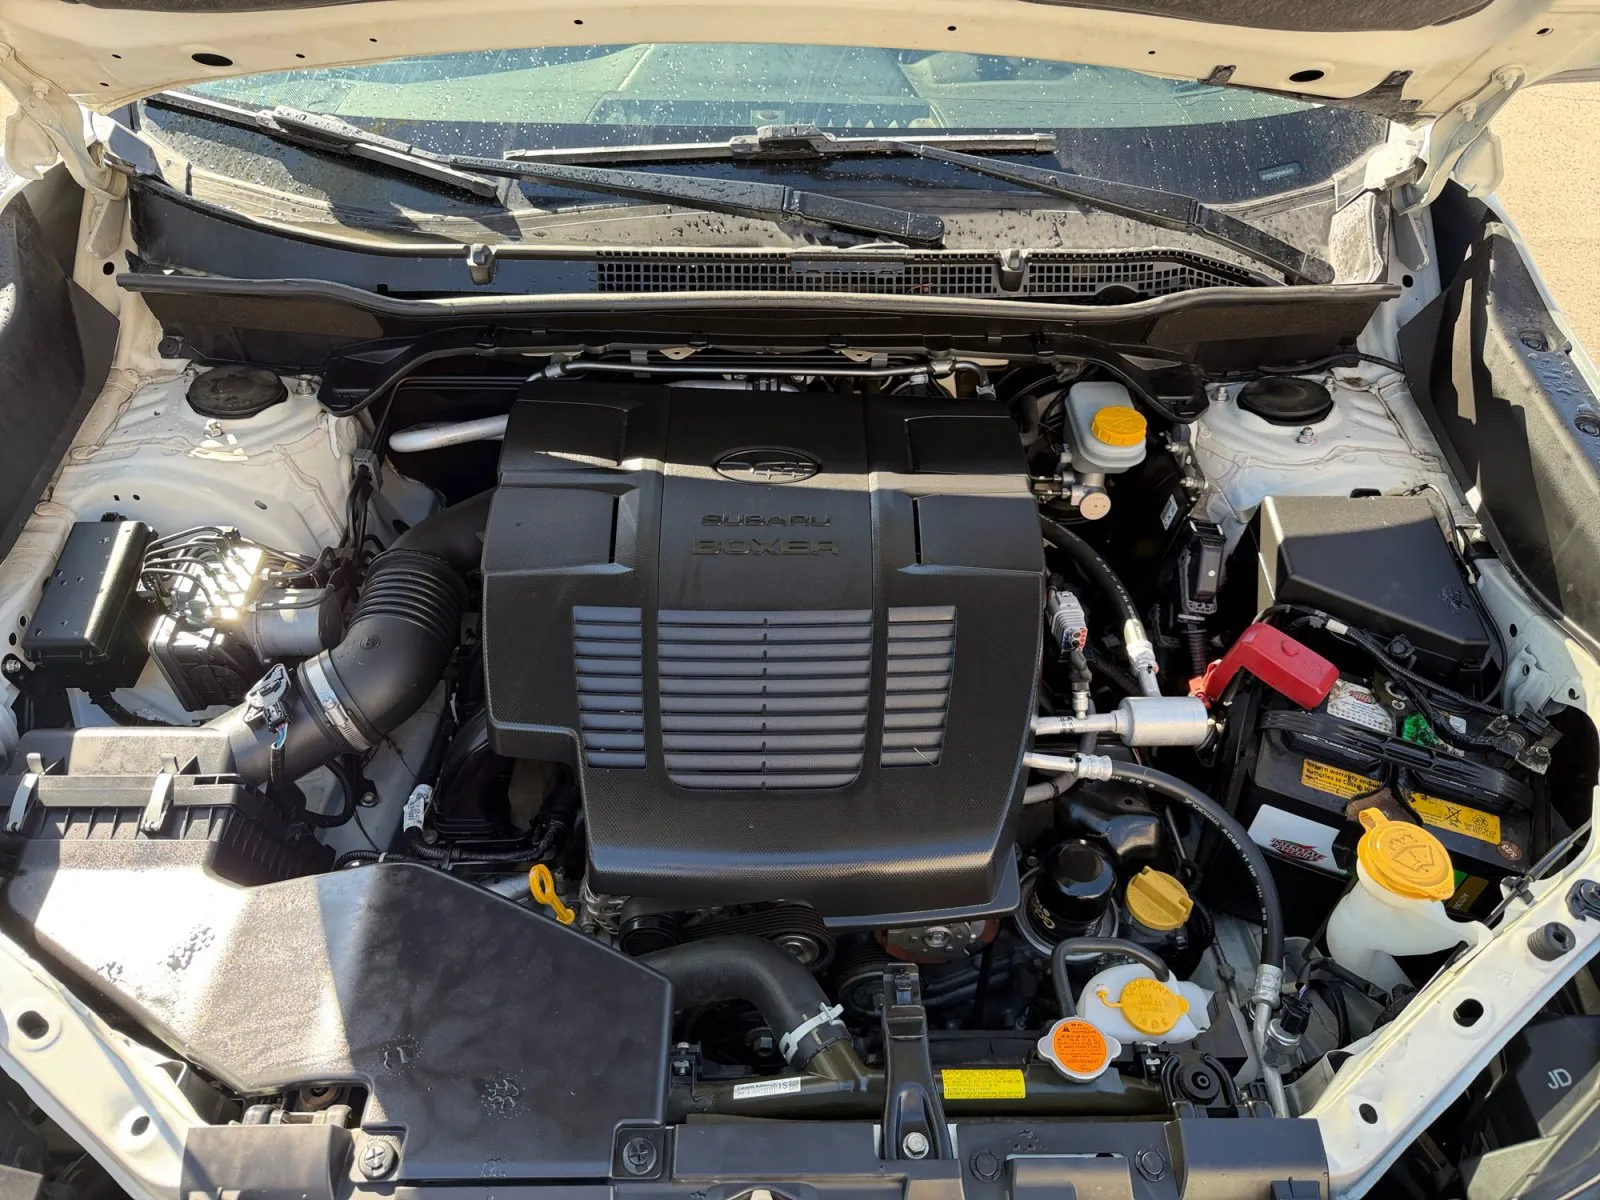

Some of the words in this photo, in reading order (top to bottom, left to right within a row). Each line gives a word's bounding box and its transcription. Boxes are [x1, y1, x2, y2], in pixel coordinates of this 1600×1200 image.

[701, 513, 831, 527] SUBARU
[692, 537, 839, 556] BOXER
[1547, 1068, 1573, 1089] JD
